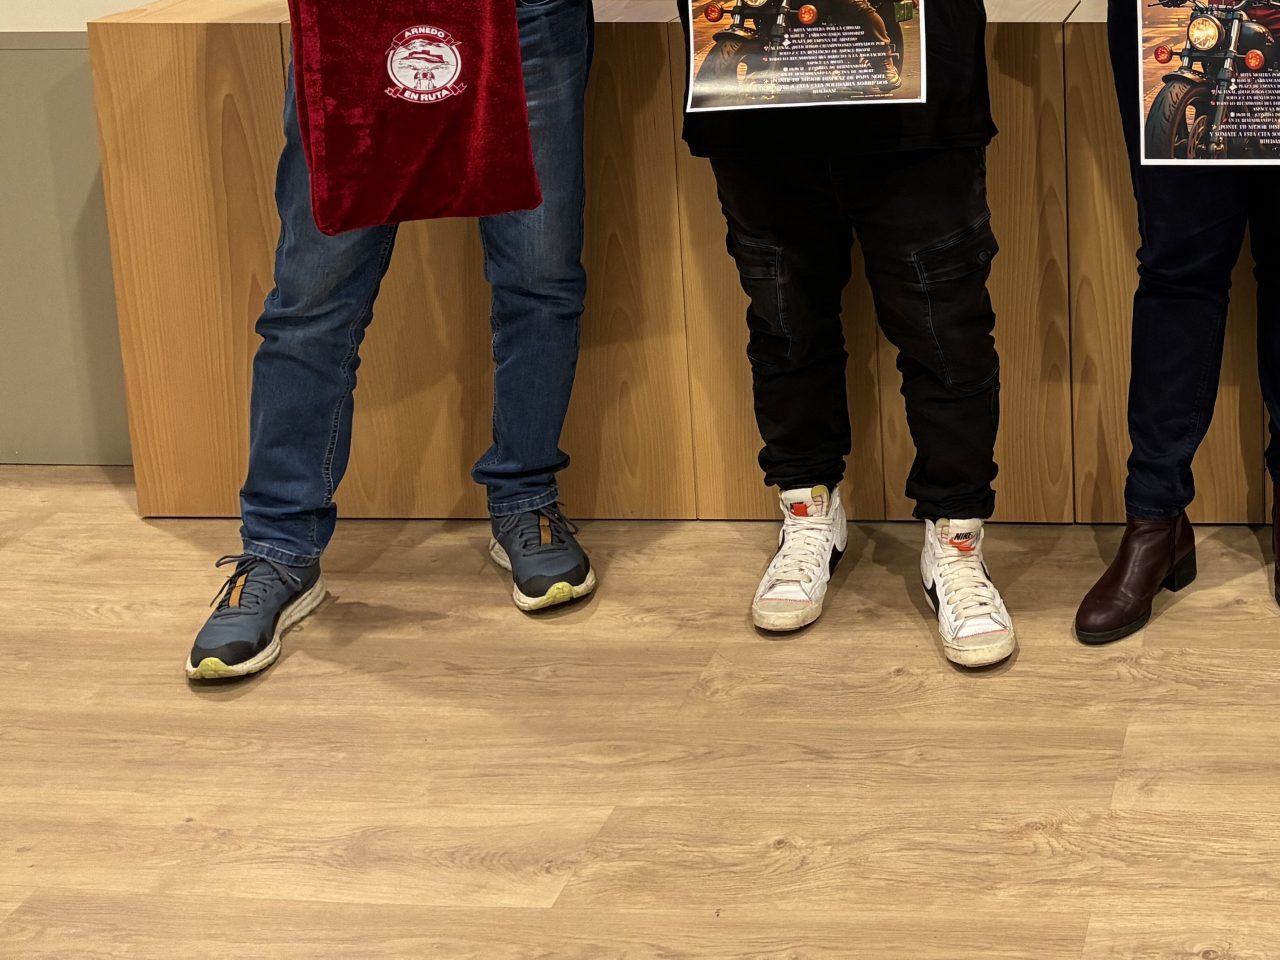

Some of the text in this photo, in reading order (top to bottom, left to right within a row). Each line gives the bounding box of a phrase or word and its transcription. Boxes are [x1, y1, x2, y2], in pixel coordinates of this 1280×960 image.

[404, 26, 445, 38] ARNEDO
[403, 89, 451, 101] EN RUTA
